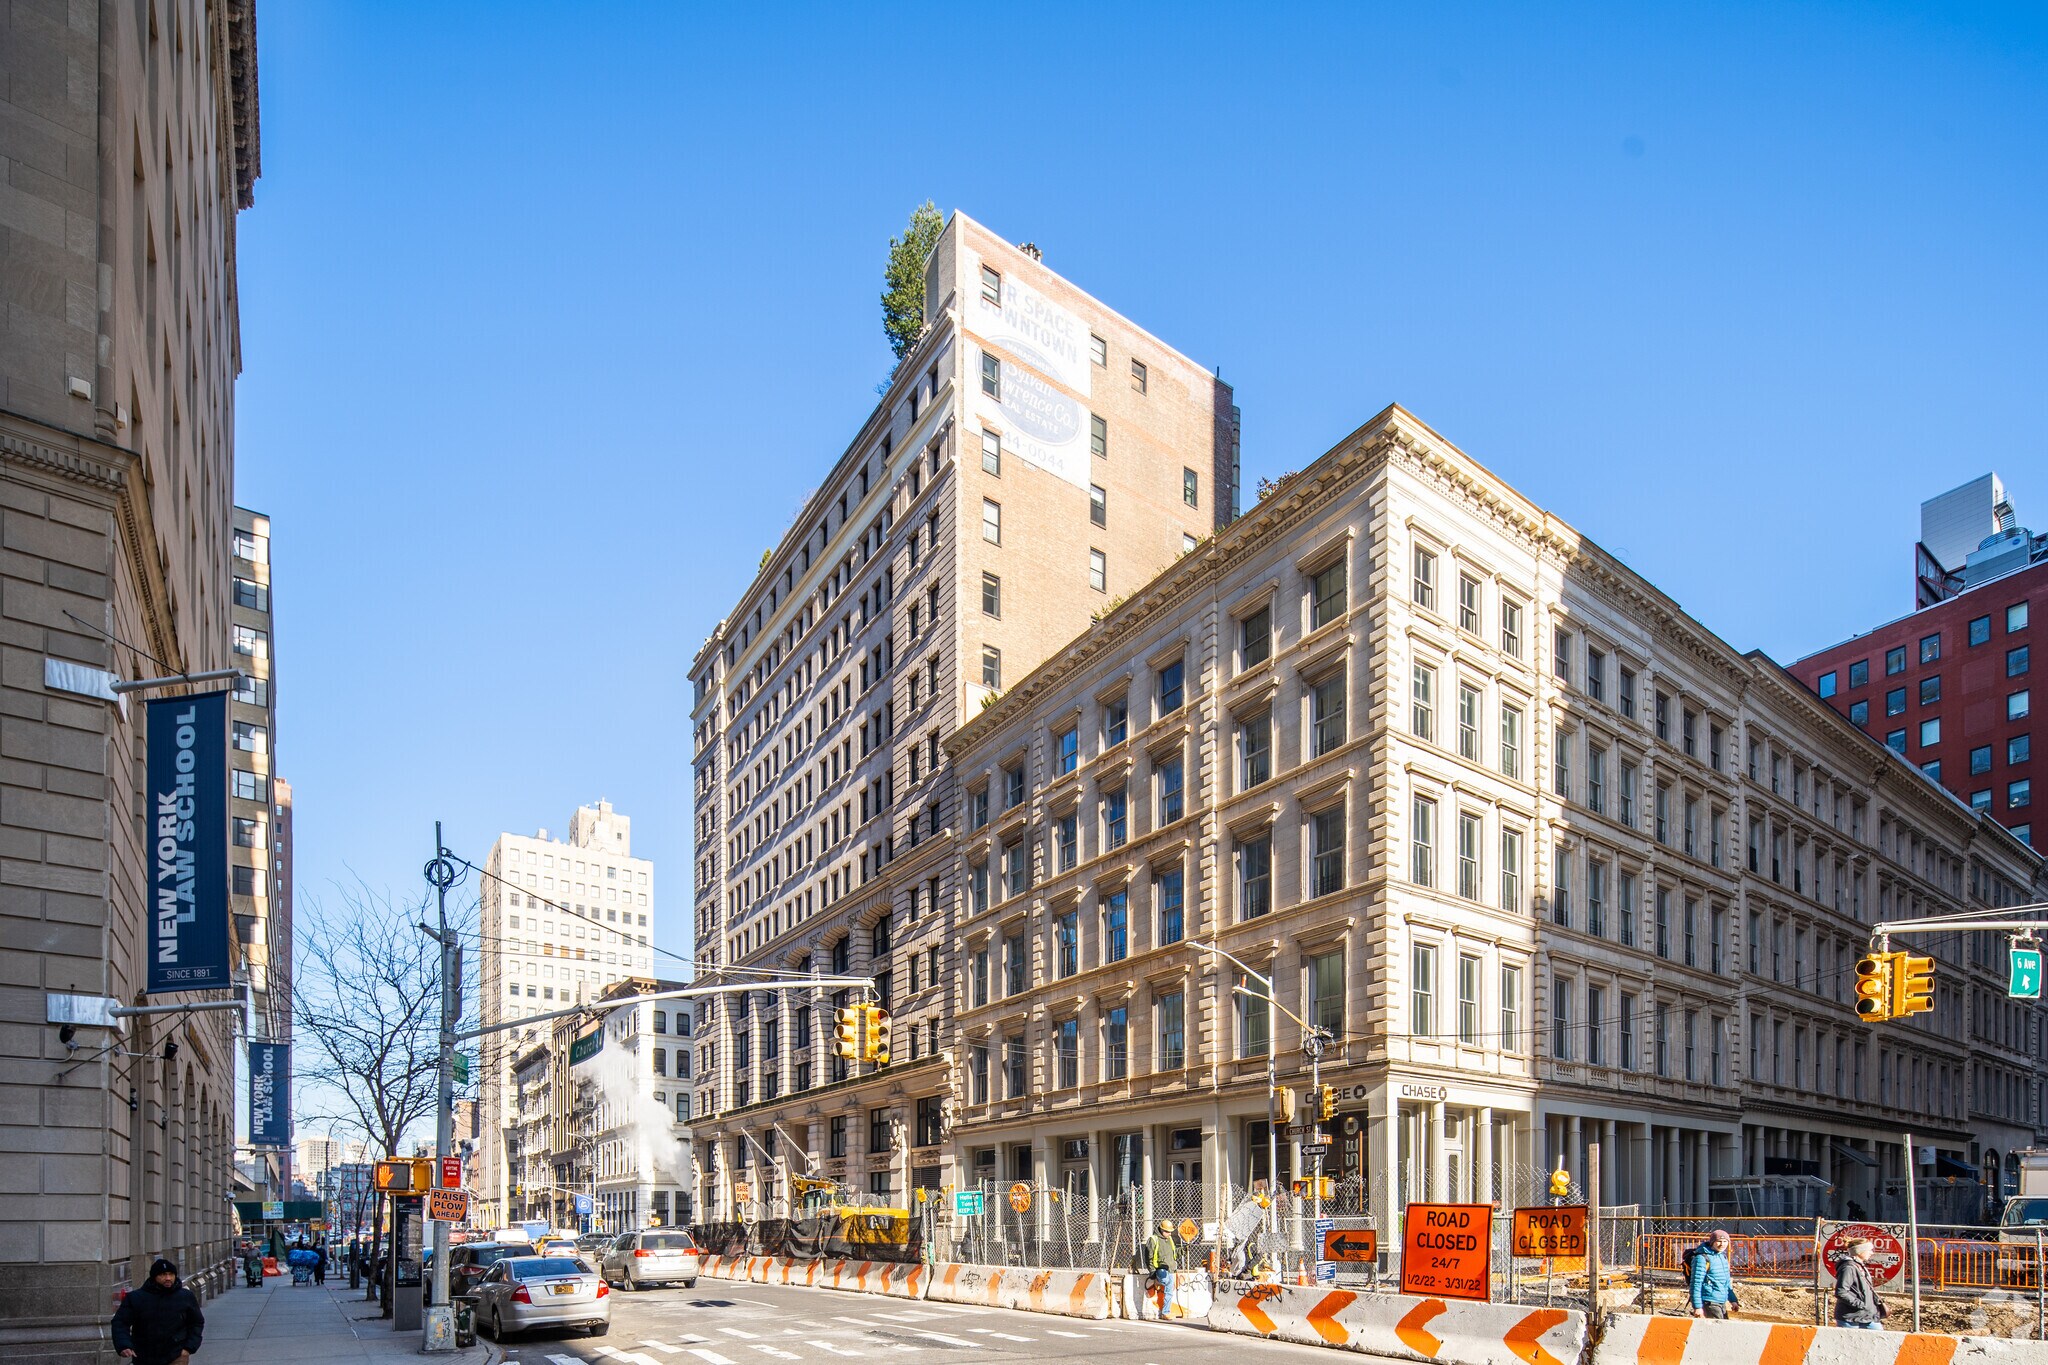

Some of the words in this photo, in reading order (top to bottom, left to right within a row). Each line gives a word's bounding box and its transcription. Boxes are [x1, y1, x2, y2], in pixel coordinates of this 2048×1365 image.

[1024, 295, 1074, 341] SPACE
[1025, 409, 1060, 434] ESTATE
[176, 705, 196, 842] SCHOOL
[158, 790, 178, 882] YORK
[176, 849, 196, 923] LAW
[158, 888, 178, 963] NEW
[2017, 957, 2022, 969] 6
[2024, 958, 2036, 970] Ave
[166, 969, 190, 979] SINCE
[193, 968, 210, 978] 1891
[263, 1046, 274, 1094] SCHOOL
[253, 1074, 264, 1107] YORK
[1402, 1084, 1437, 1099] CHASE
[263, 1096, 273, 1122] LAW
[253, 1108, 264, 1135] NEW
[1306, 1125, 1312, 1133] ST
[433, 1191, 466, 1202] RAISE
[736, 1184, 749, 1193] RAISE
[433, 1201, 463, 1211] PLOW
[436, 1210, 461, 1219] AHEAD
[1426, 1211, 1470, 1228] ROAD
[1528, 1214, 1571, 1229] ROAD
[1180, 1226, 1196, 1234] SLOW
[1417, 1232, 1477, 1251] CLOSED
[1518, 1234, 1580, 1249] CLOSED
[1431, 1257, 1461, 1269] 24/7
[1407, 1274, 1436, 1287] 1/2/22
[1445, 1277, 1481, 1291] 3/31/22
